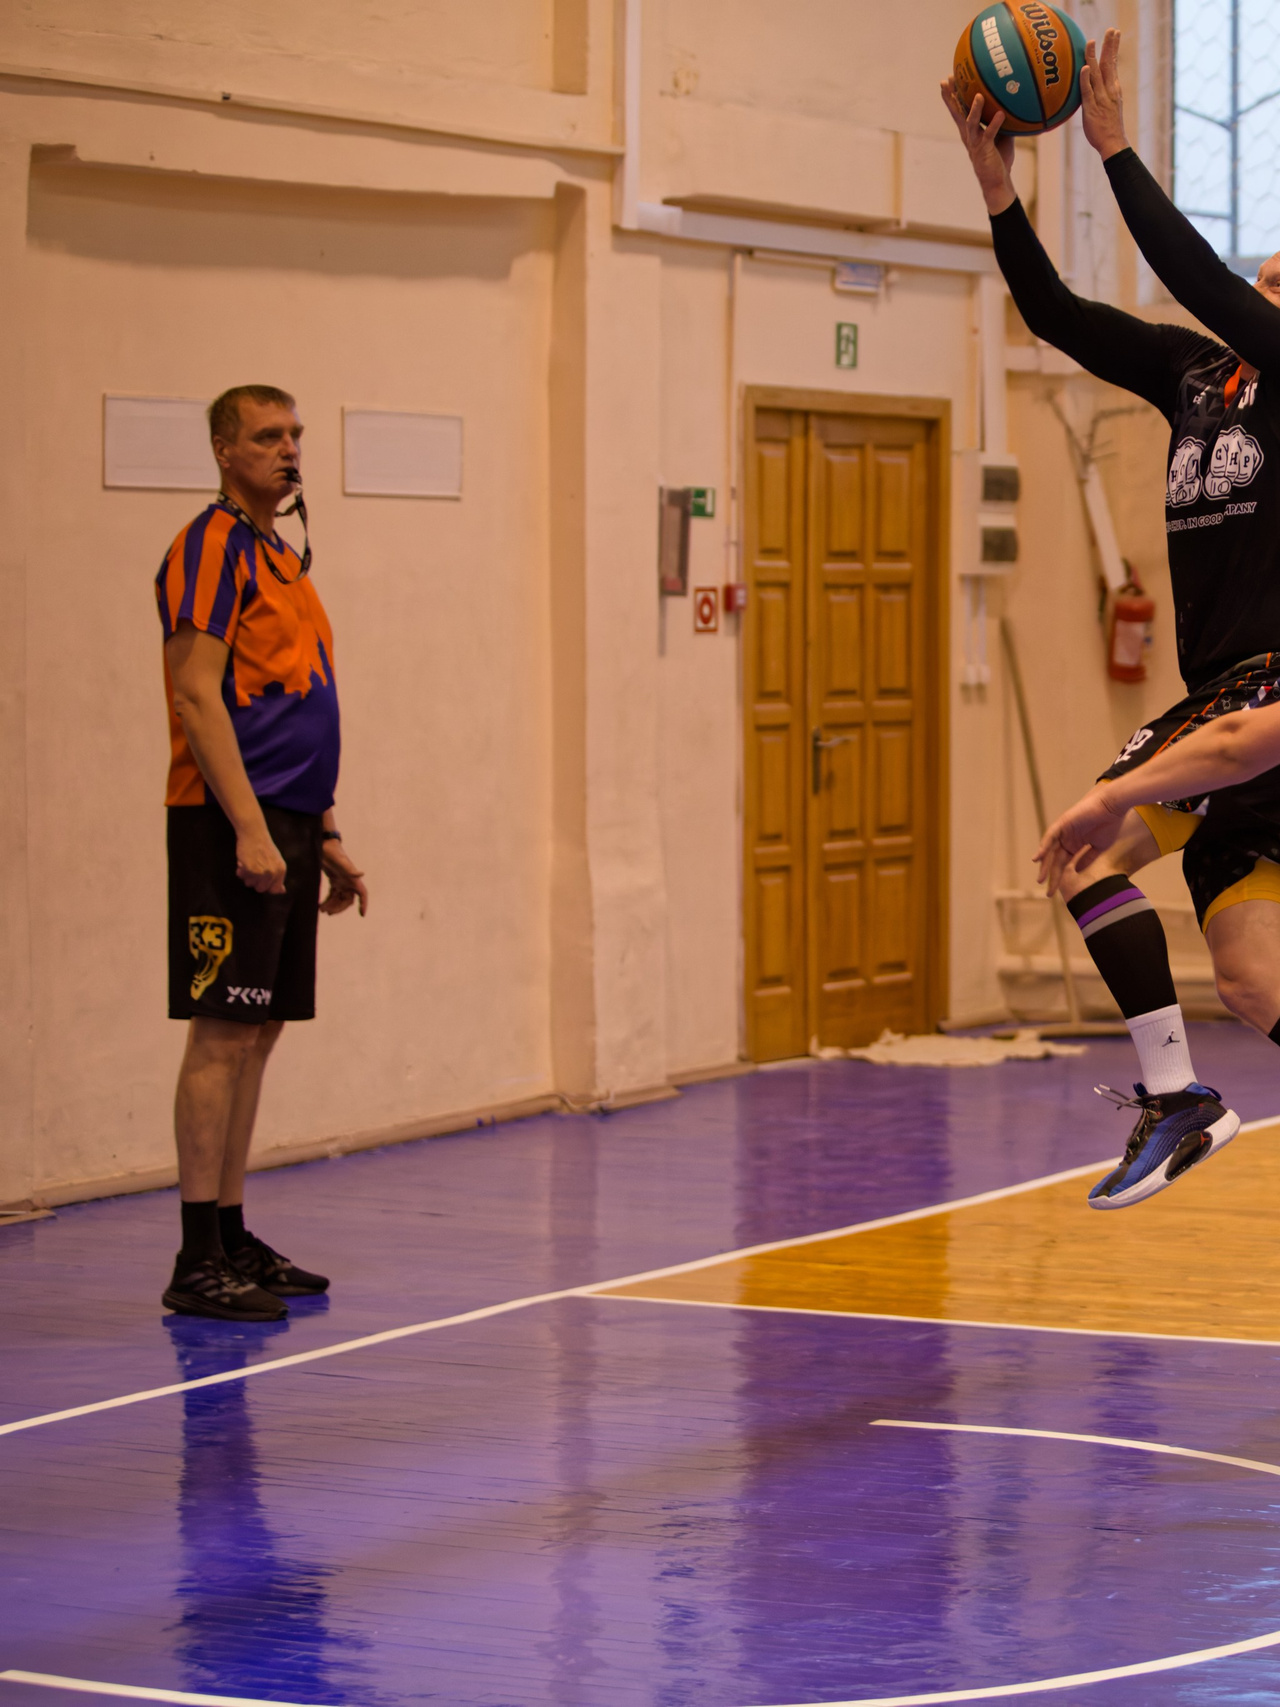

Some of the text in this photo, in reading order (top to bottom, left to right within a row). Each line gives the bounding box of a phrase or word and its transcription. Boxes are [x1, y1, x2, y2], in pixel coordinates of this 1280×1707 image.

[981, 16, 1014, 79] SIBUR
[1019, 2, 1060, 87] Wilson
[1187, 516, 1198, 529] IN
[1198, 513, 1224, 527] GOOD
